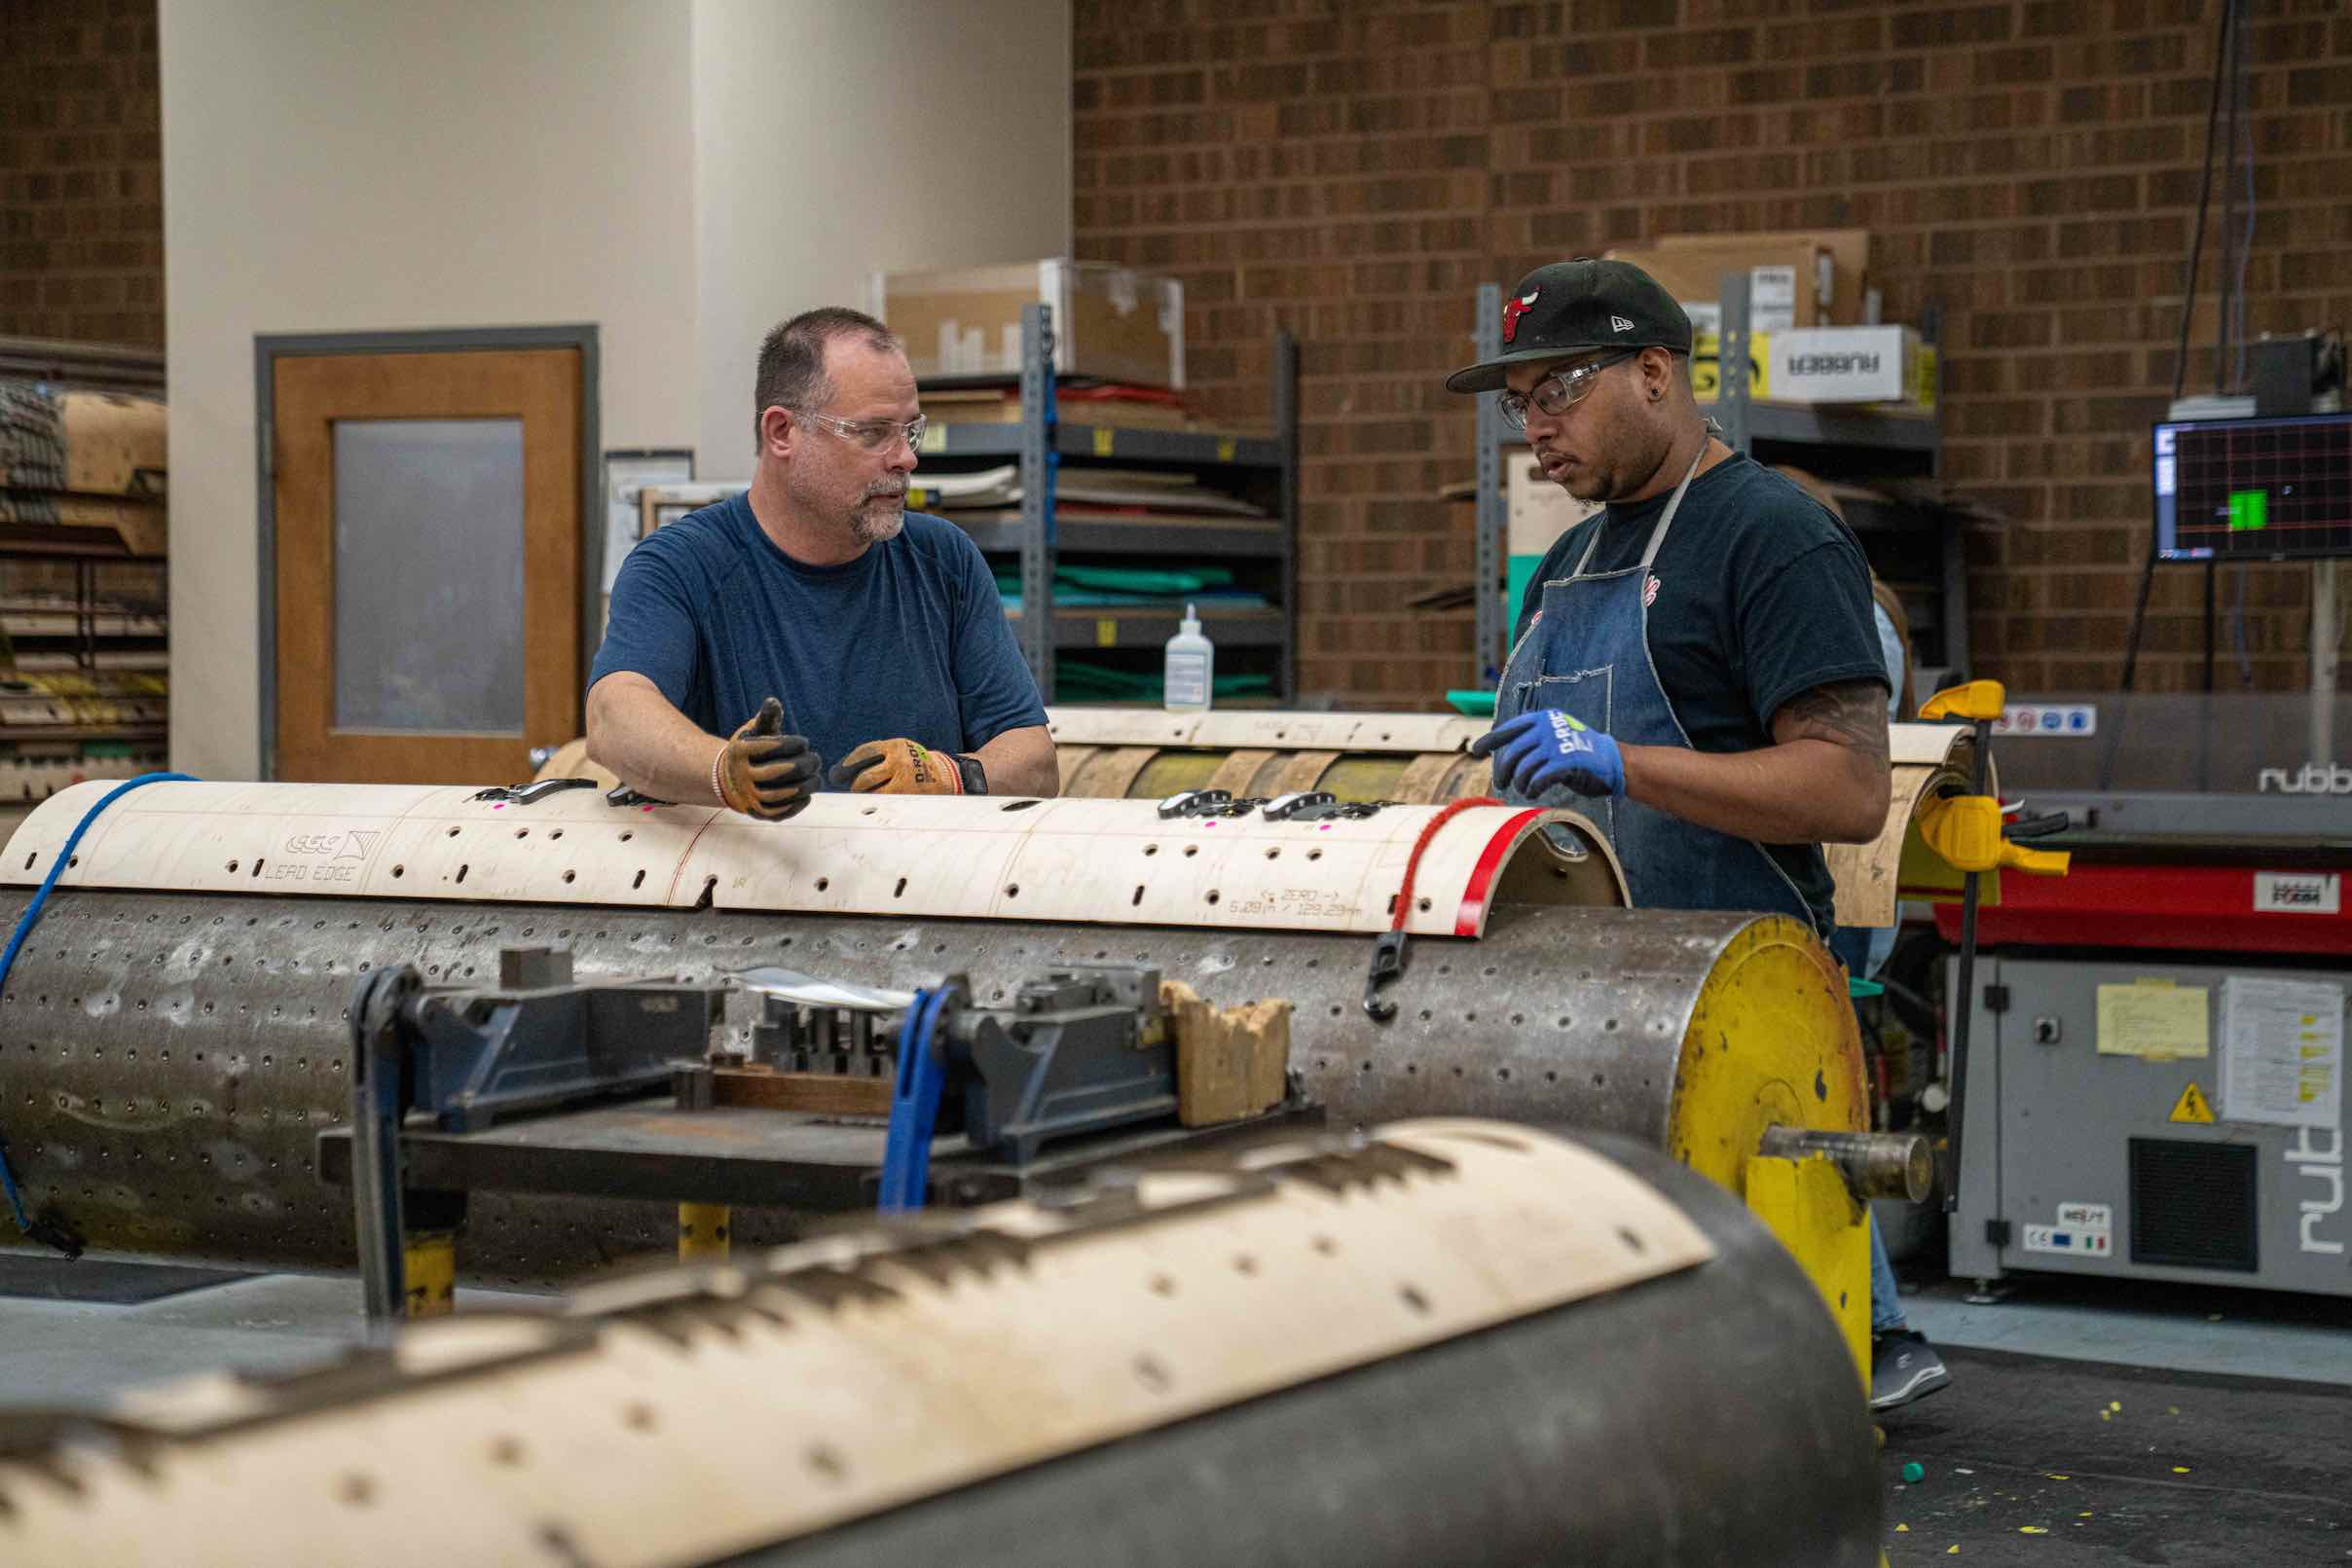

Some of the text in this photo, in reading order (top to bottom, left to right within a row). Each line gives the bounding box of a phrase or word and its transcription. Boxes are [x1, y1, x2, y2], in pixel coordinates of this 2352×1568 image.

[1787, 352, 1880, 376] RUBBER
[2259, 762, 2352, 794] rubb
[265, 864, 357, 882] LEAD EDGE
[1280, 889, 1318, 902] ZERO
